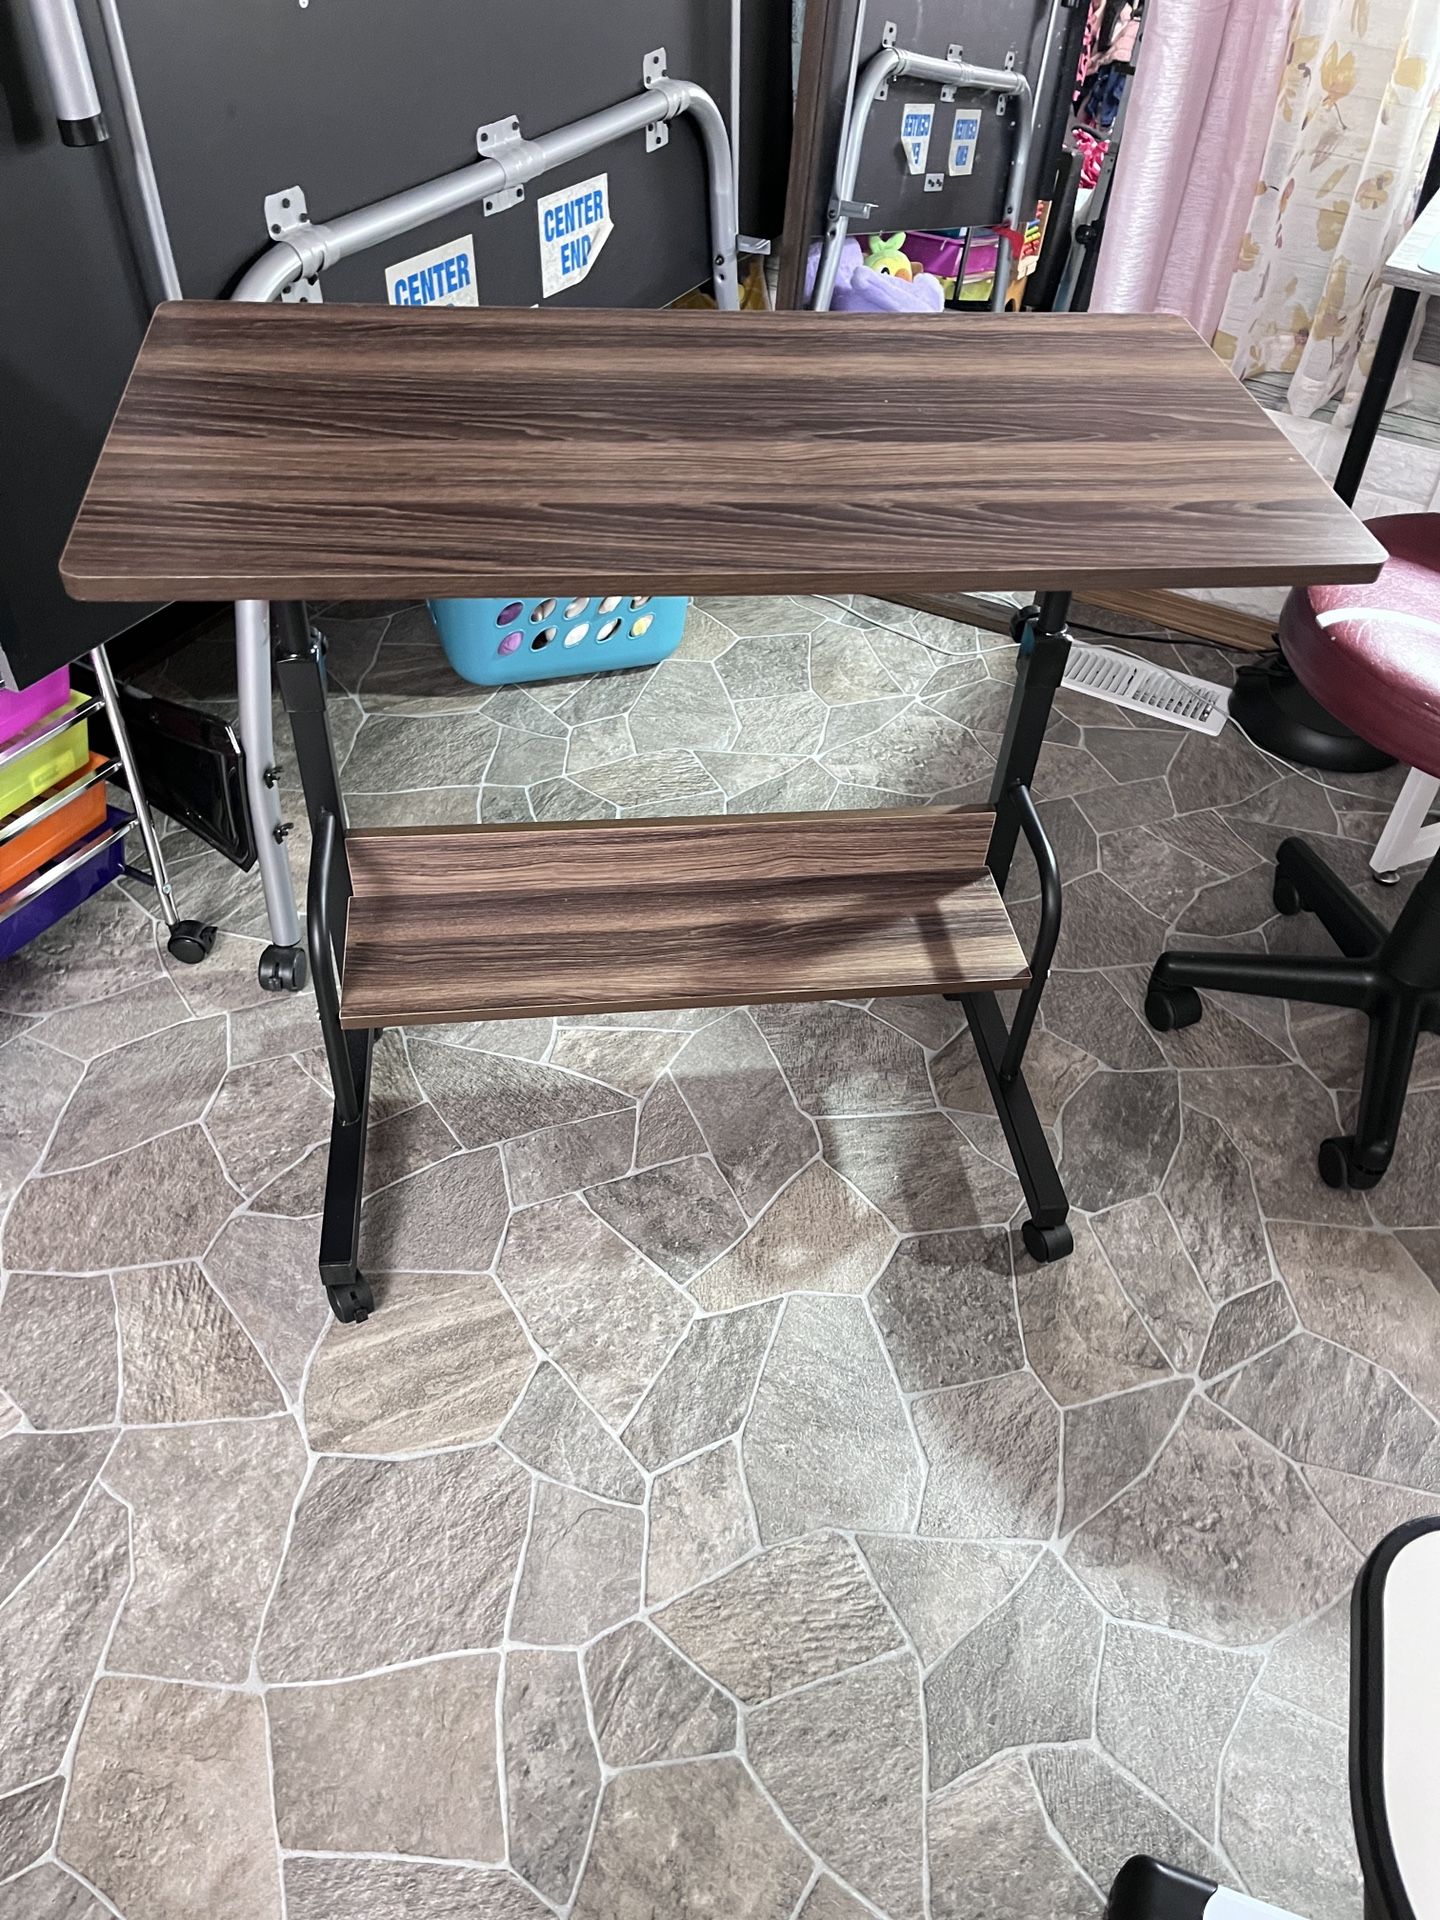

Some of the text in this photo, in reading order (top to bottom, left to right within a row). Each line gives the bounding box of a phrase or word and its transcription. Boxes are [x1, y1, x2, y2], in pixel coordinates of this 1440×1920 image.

[544, 189, 604, 242] CENTER
[394, 252, 471, 306] CENTER
[561, 234, 592, 275] END
